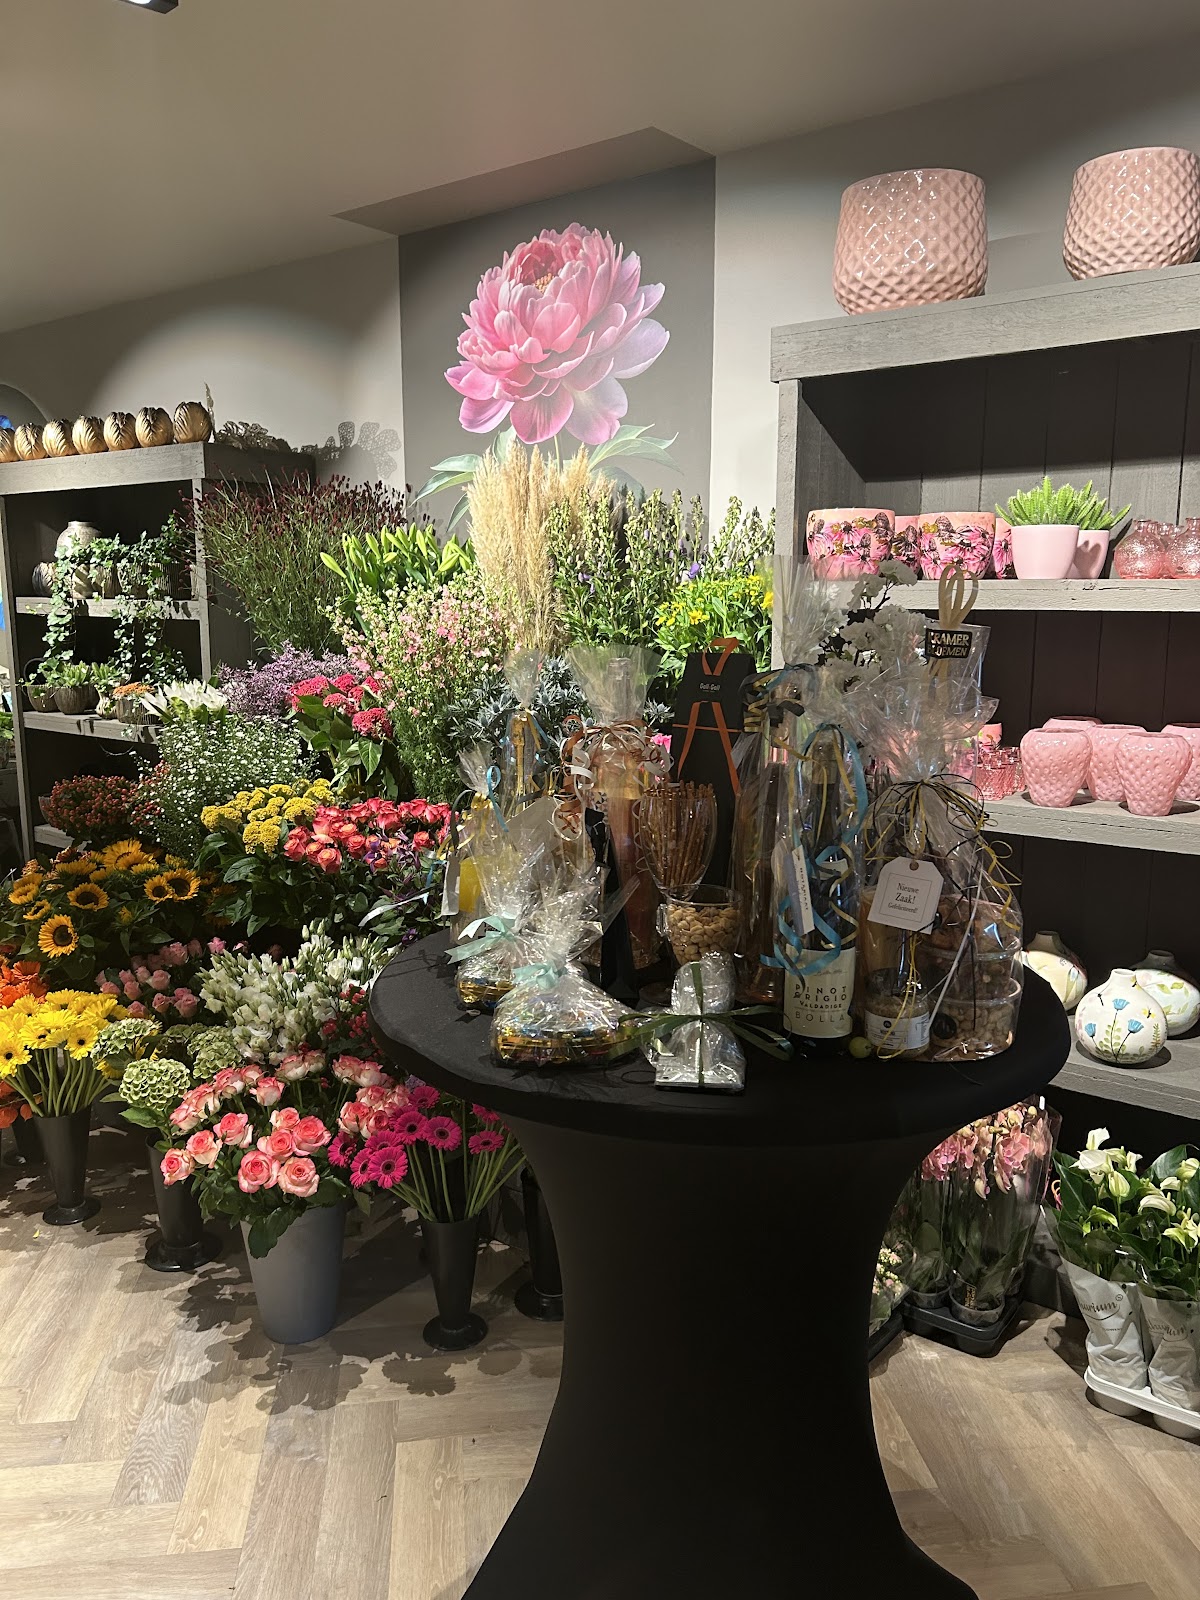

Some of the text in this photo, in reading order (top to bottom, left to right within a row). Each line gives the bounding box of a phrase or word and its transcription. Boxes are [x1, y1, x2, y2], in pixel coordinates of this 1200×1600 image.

[896, 882, 919, 894] Nieuwe
[895, 892, 916, 905] Zaak!
[795, 983, 847, 994] PINOT
[799, 1000, 842, 1009] VALDADIGE
[795, 1011, 845, 1023] BOLLA
